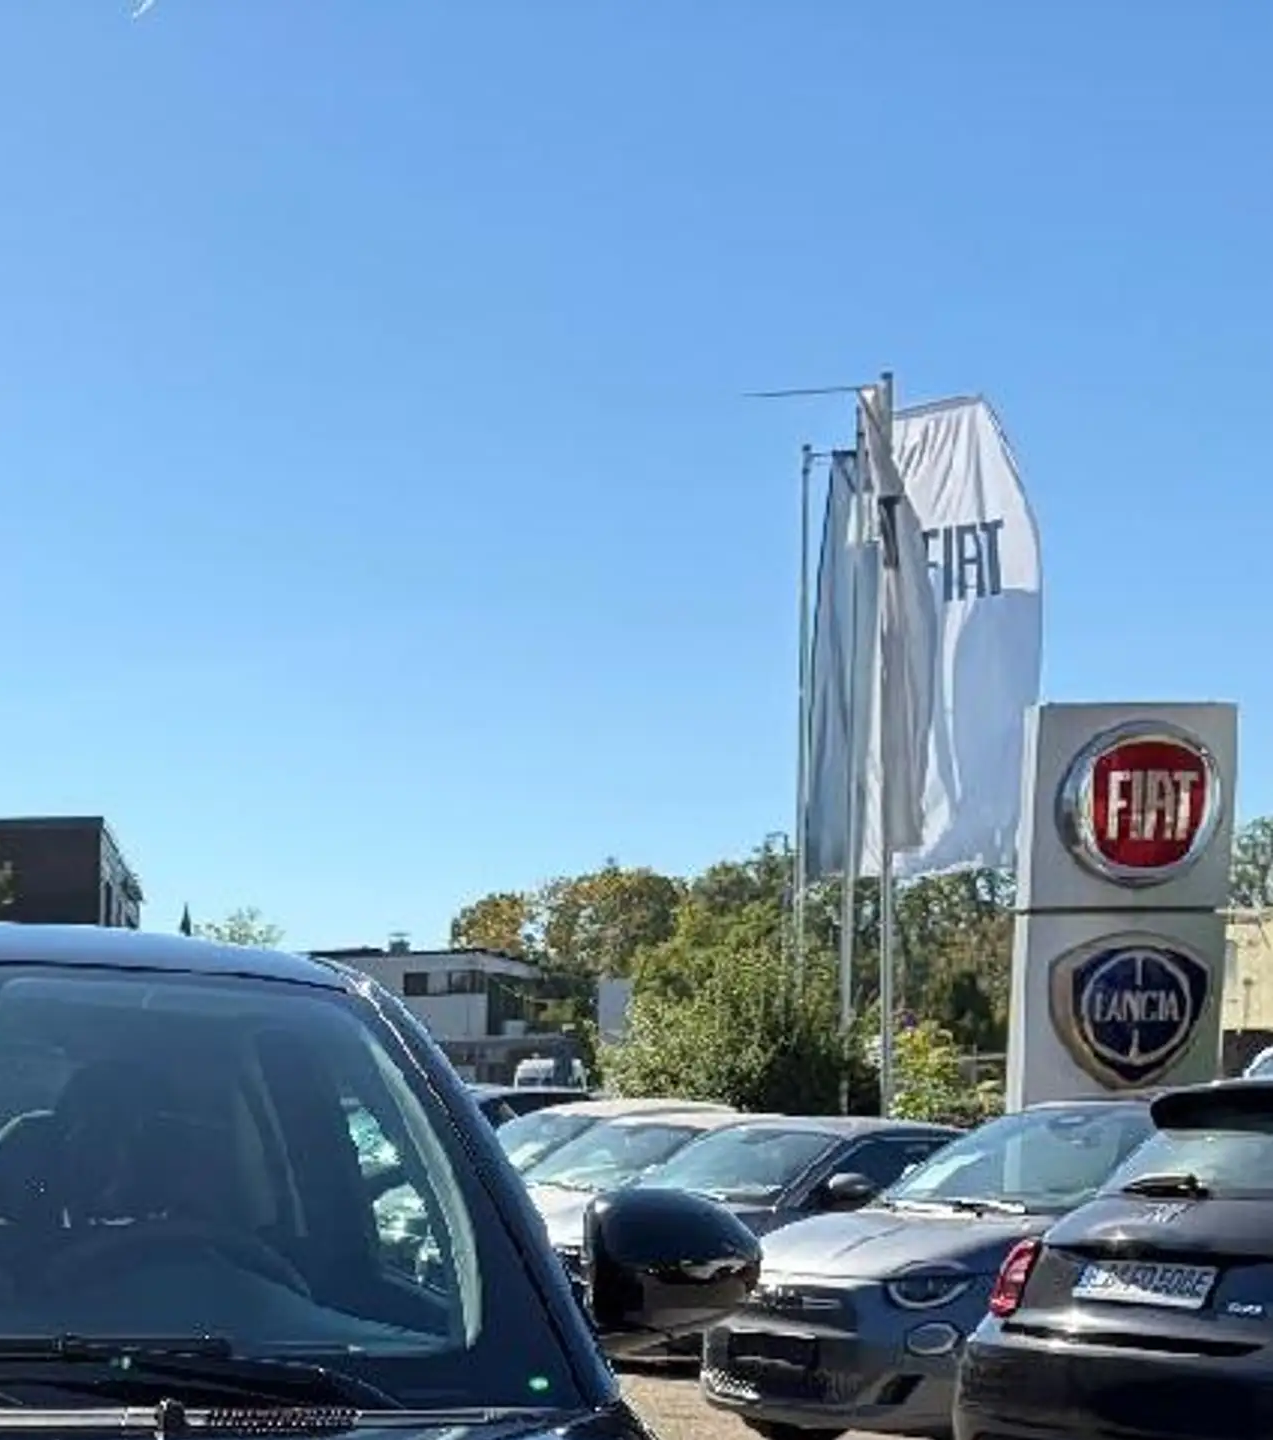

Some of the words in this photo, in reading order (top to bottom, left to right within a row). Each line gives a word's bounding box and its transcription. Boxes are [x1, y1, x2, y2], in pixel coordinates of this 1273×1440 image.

[921, 519, 1004, 602] FIAT
[1106, 769, 1199, 841] FIAT
[1093, 988, 1181, 1023] LANCIA
